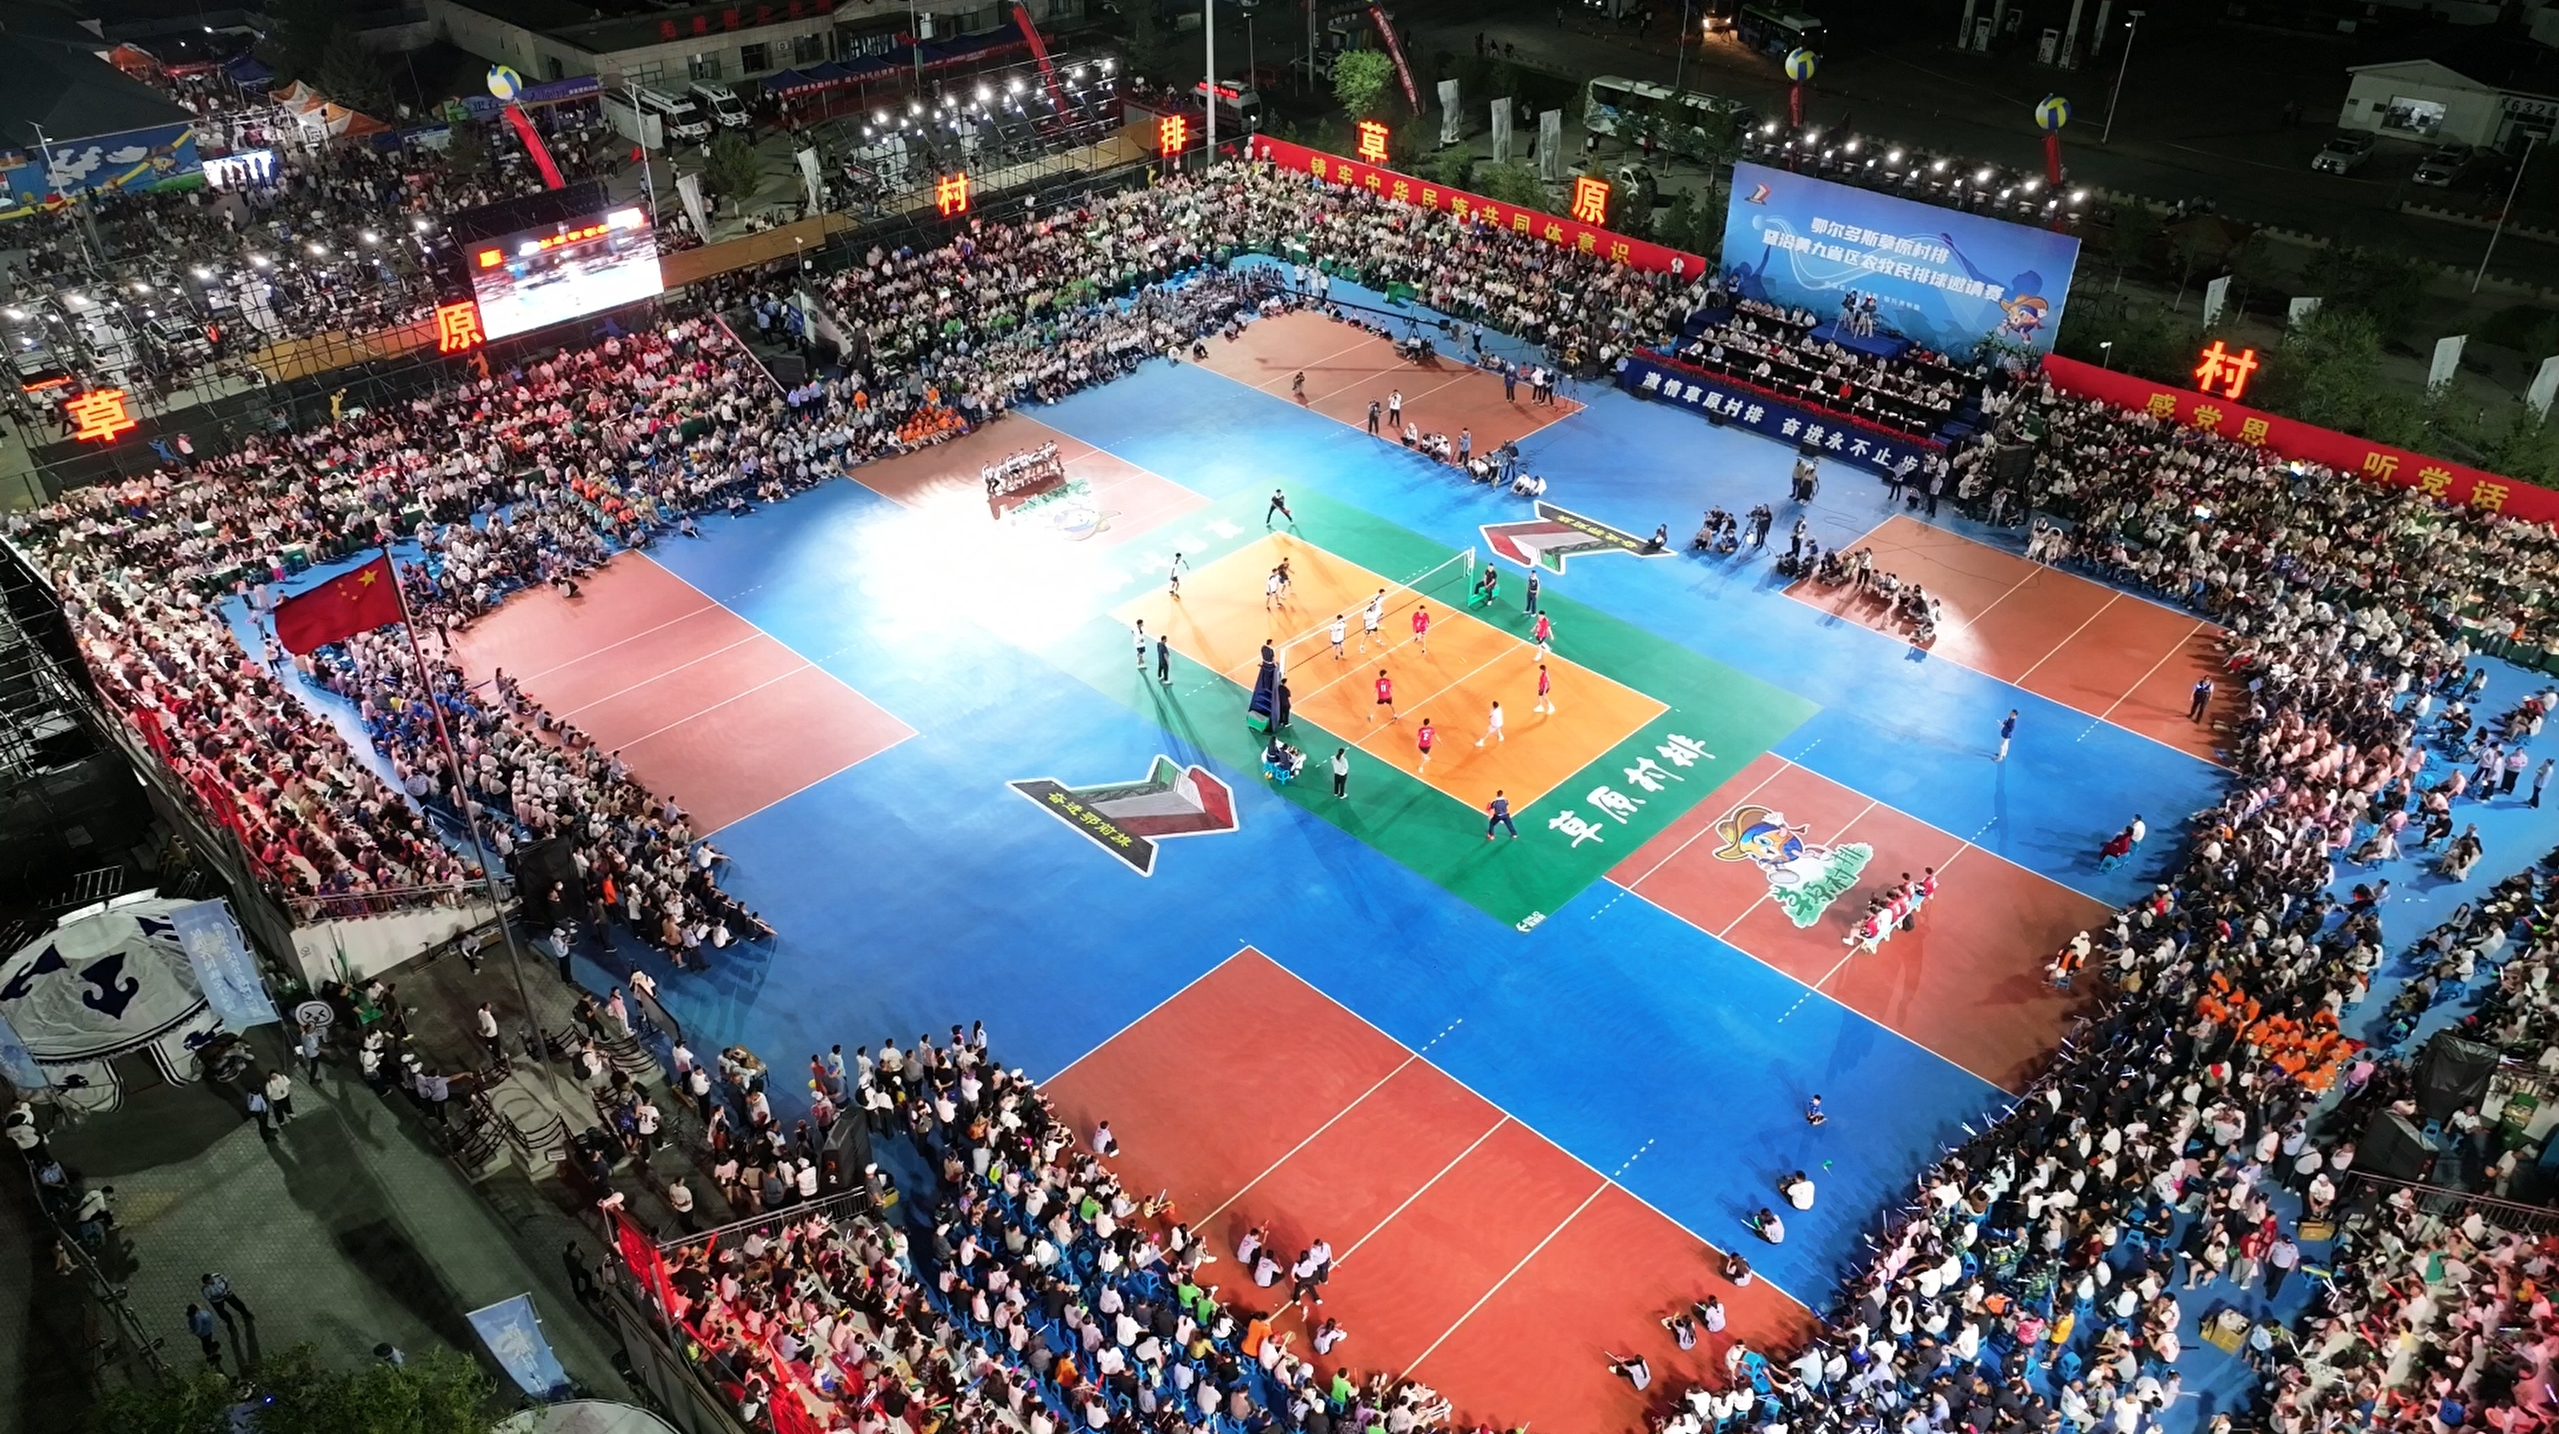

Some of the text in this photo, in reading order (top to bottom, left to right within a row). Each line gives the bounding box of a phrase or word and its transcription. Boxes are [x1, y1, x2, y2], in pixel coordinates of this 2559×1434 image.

[1310, 156, 1631, 265] 铸牢中华民族共同体意识
[1358, 121, 2258, 400] 草 原 村
[1762, 229, 2005, 303] 暨沿黄九省区农牧民排球邀请赛
[1810, 217, 1950, 265] 鄂尔多斯草原村排
[65, 115, 1187, 442] 草 原 村 排
[1642, 371, 1919, 472] 激情草原村排 奋进永不止步
[2146, 392, 2509, 512] 感党恩 听党话
[1549, 733, 1716, 848] 草原村排
